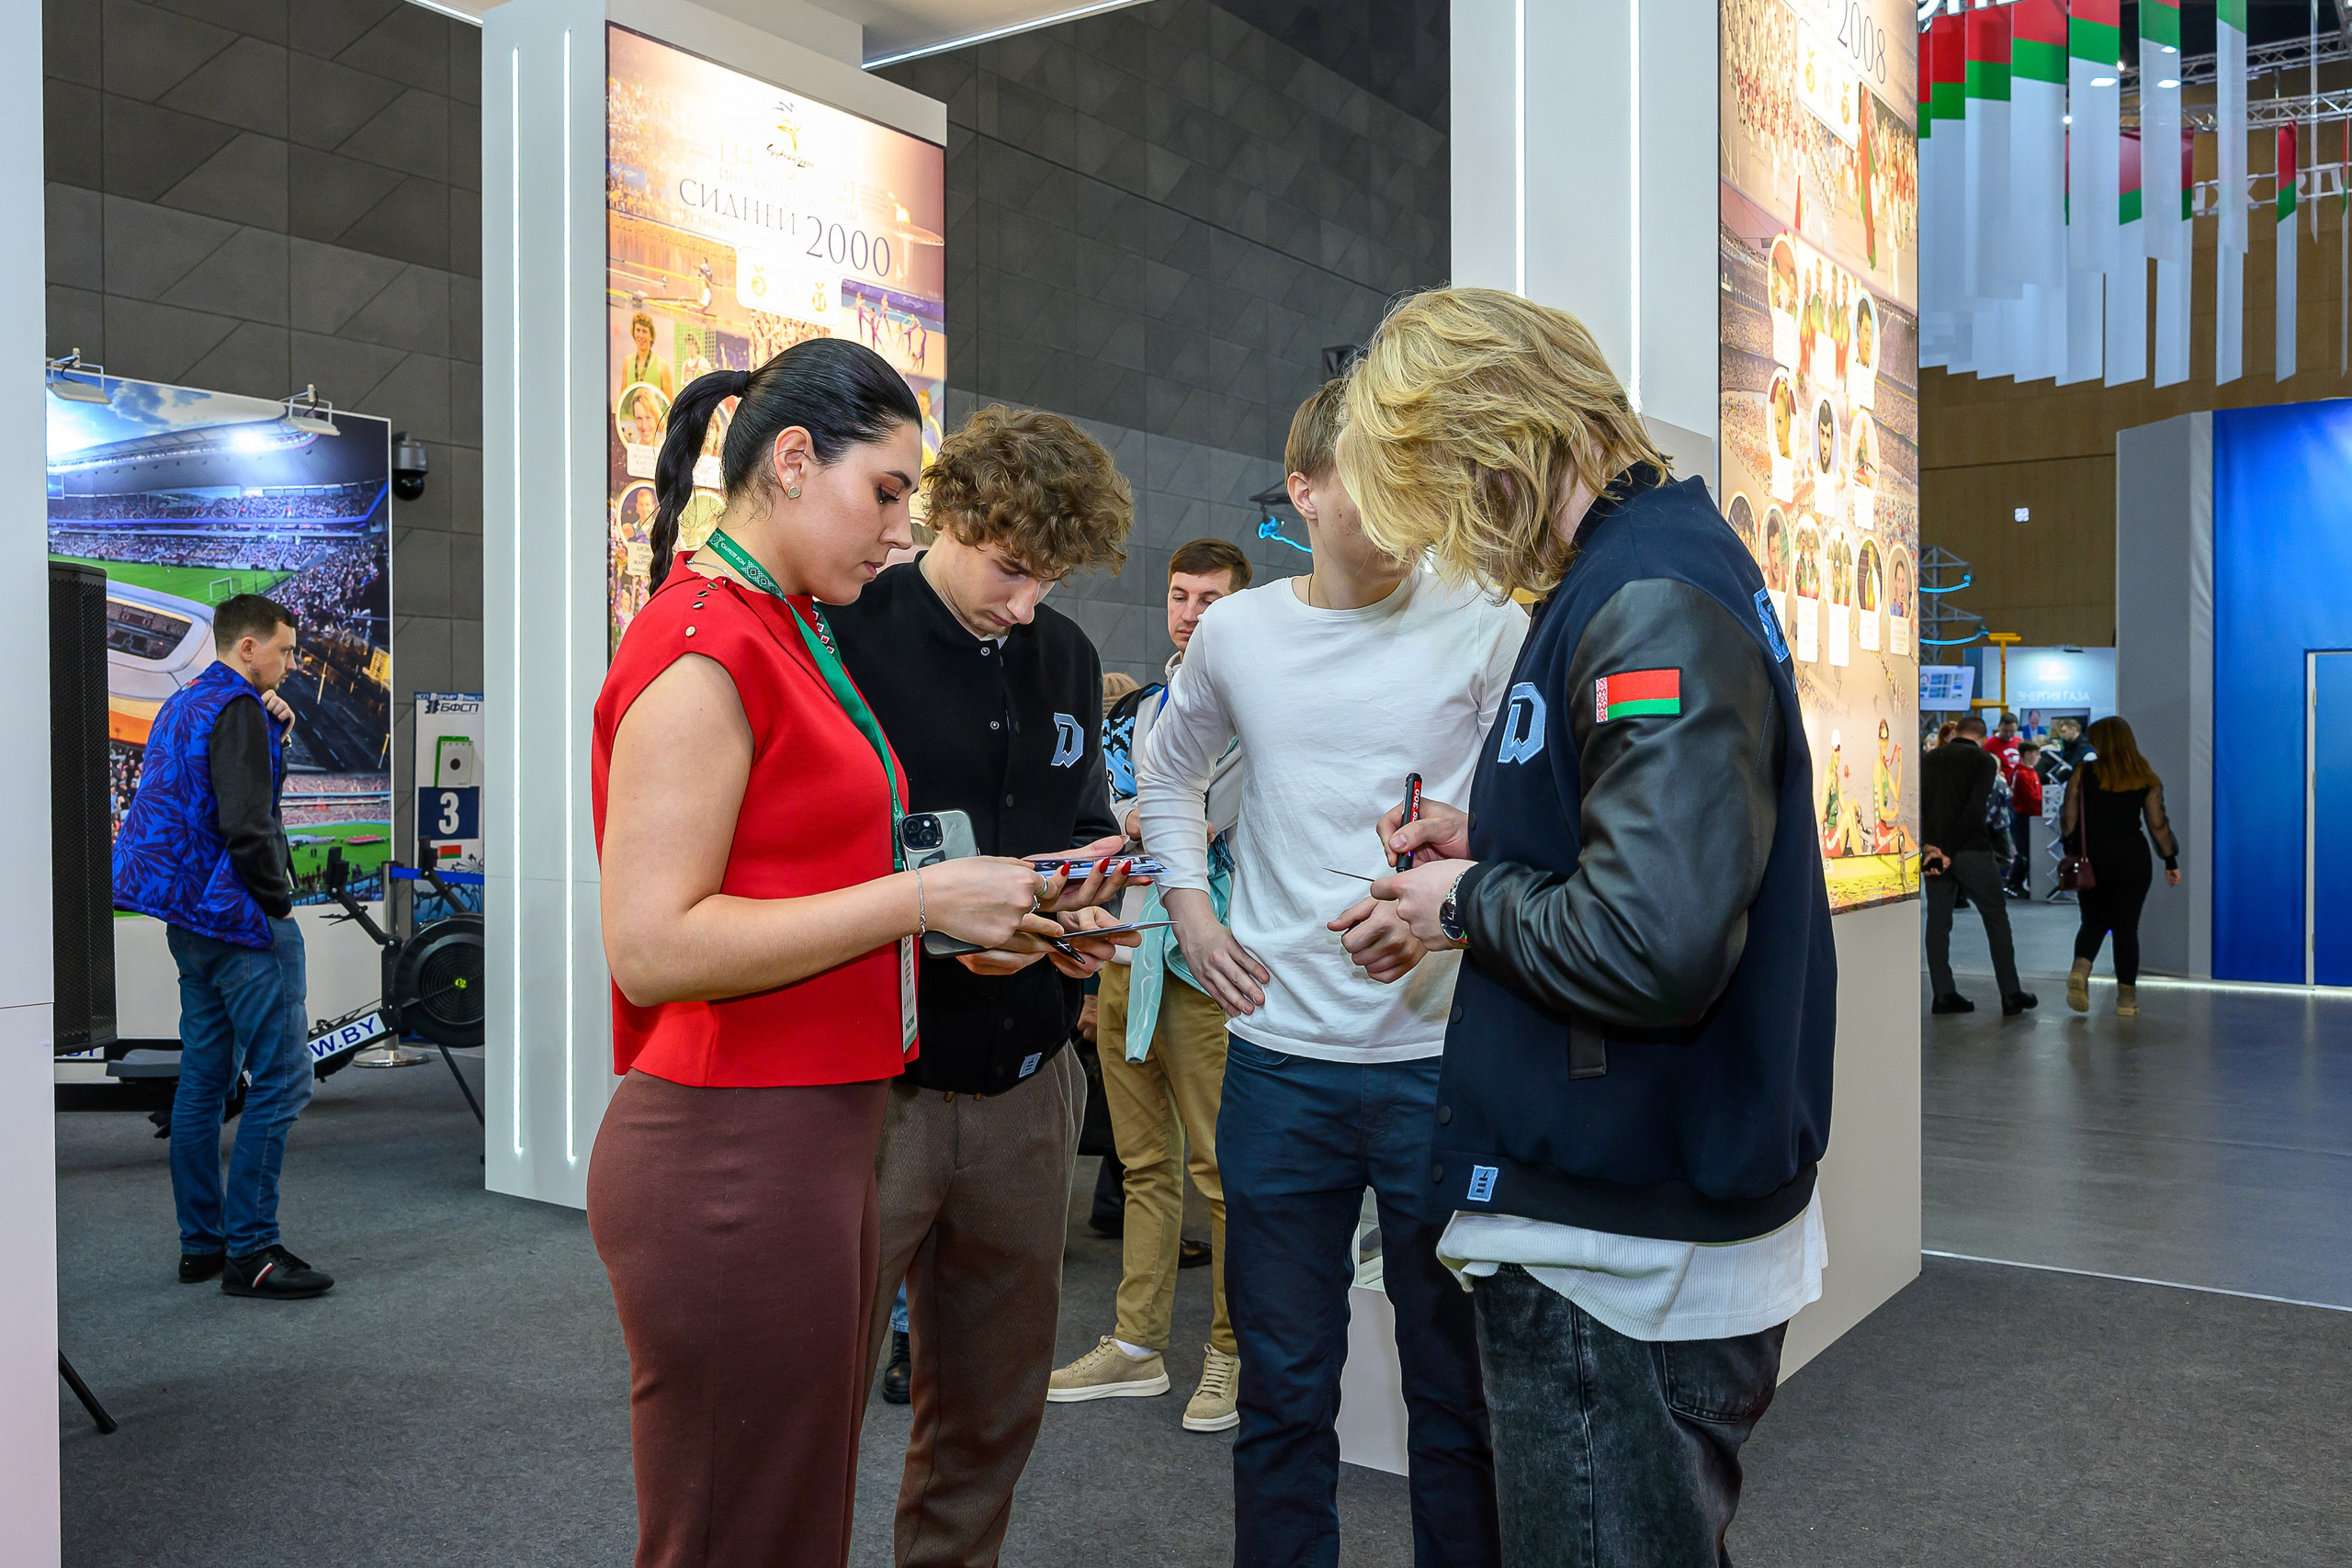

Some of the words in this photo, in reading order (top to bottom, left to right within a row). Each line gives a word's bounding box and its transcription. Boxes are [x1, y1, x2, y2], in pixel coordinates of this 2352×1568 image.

[1838, 0, 1886, 85] 2008
[679, 178, 796, 235] СИДНЕЙ
[806, 215, 890, 277] 2000
[440, 703, 479, 713] БФСП
[2063, 691, 2090, 702] ГАЗА
[1050, 712, 1084, 769] D
[1497, 681, 1546, 765] D
[438, 791, 459, 835] 3
[309, 1016, 375, 1057] W.BY
